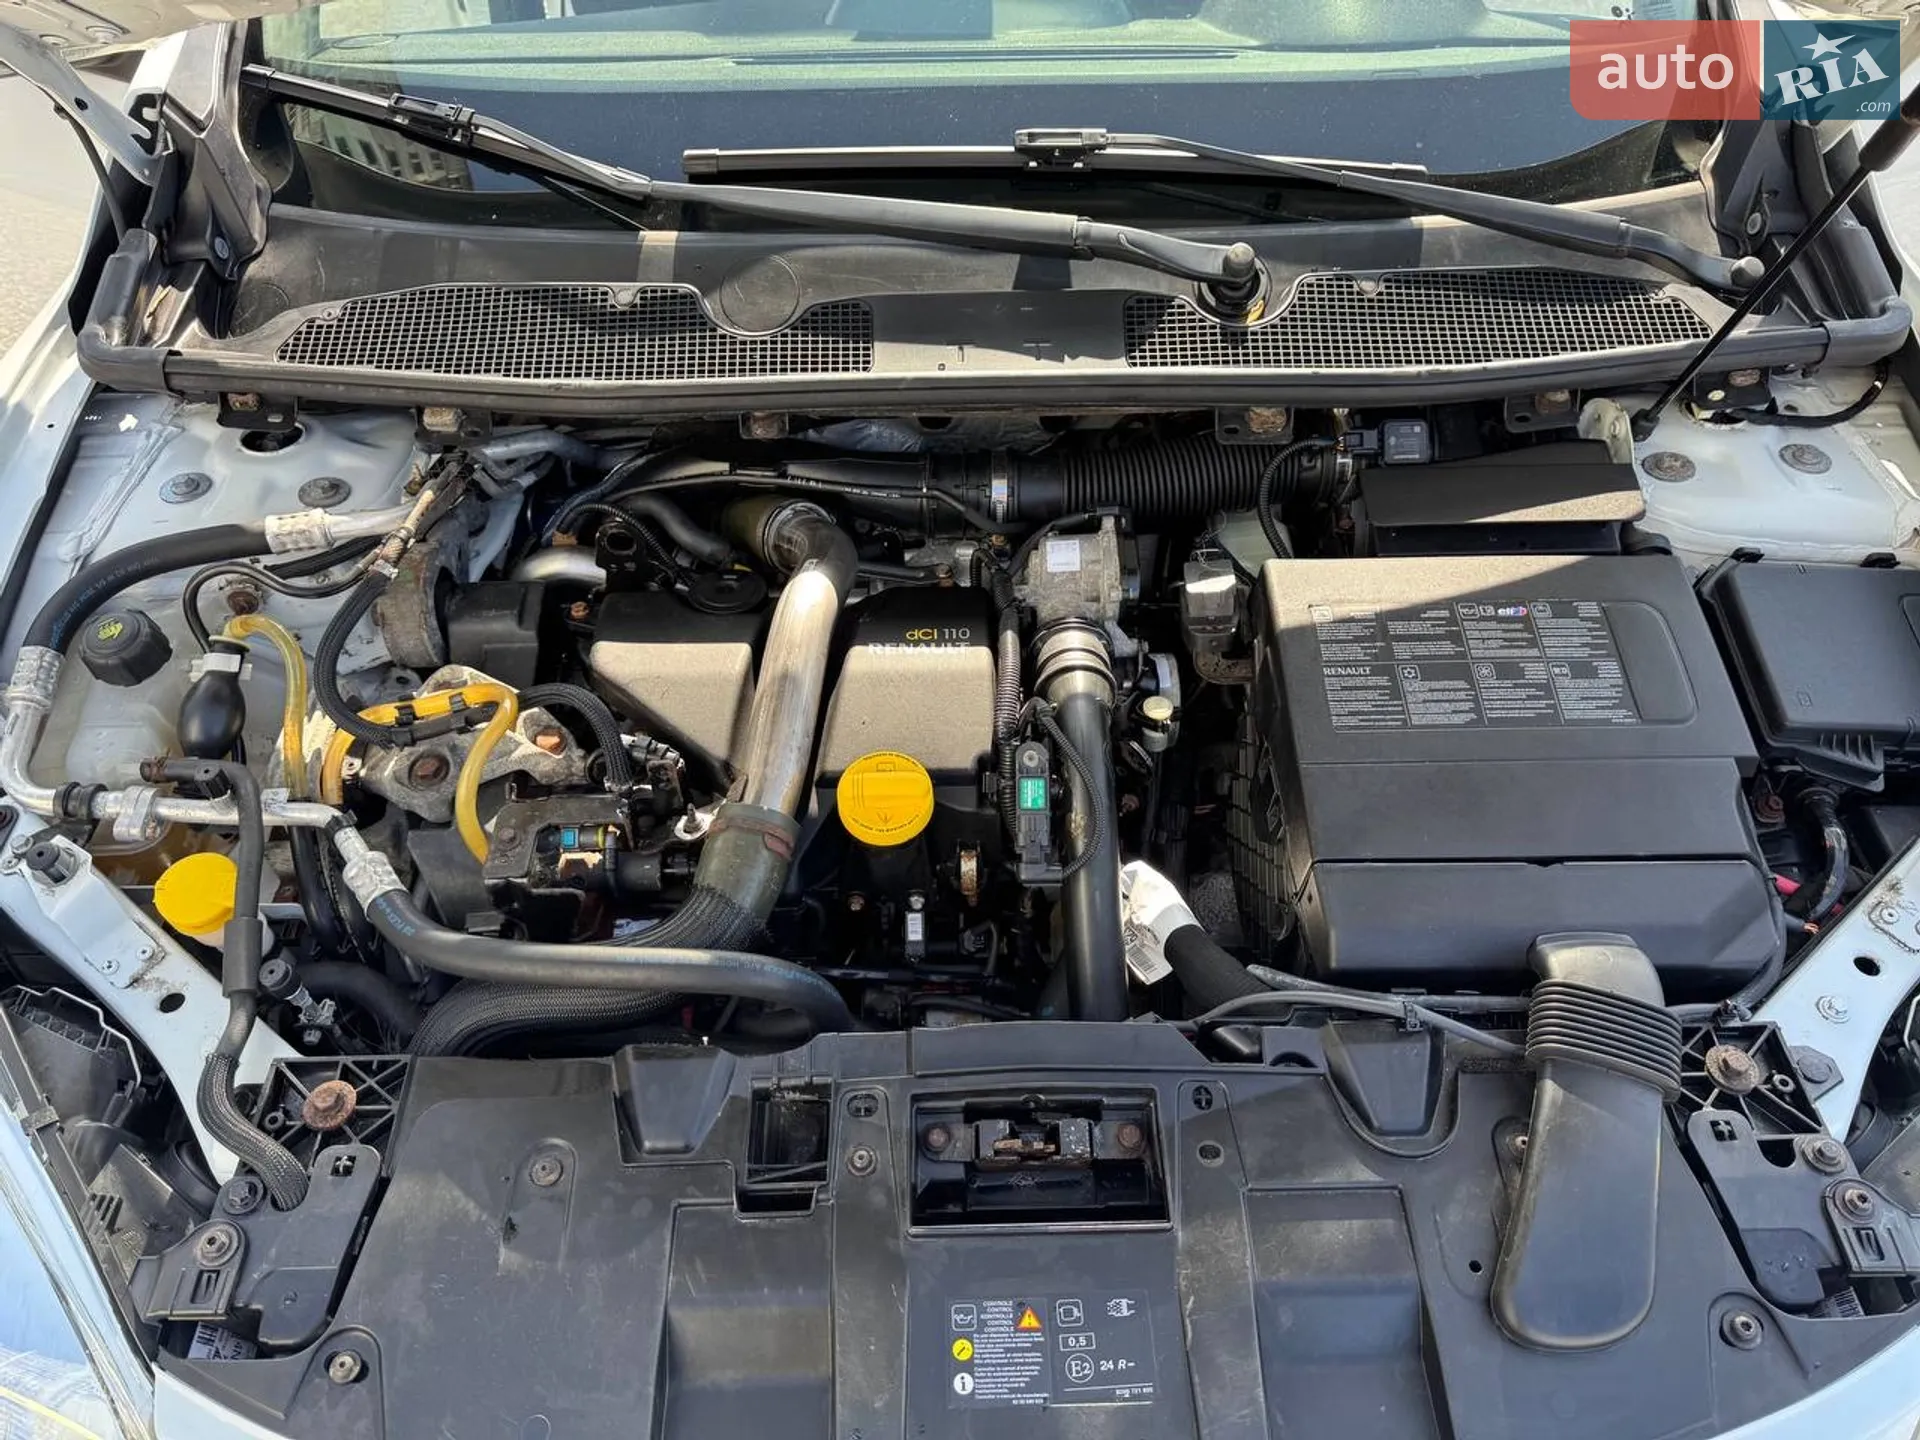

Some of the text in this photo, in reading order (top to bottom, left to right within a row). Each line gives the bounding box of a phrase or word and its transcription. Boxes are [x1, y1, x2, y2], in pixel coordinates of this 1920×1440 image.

[942, 628, 970, 640] 110
[1322, 666, 1372, 676] RENAULT
[1068, 1336, 1087, 1348] 0,5
[1070, 1360, 1091, 1377] E2
[1100, 1360, 1114, 1371] 24
